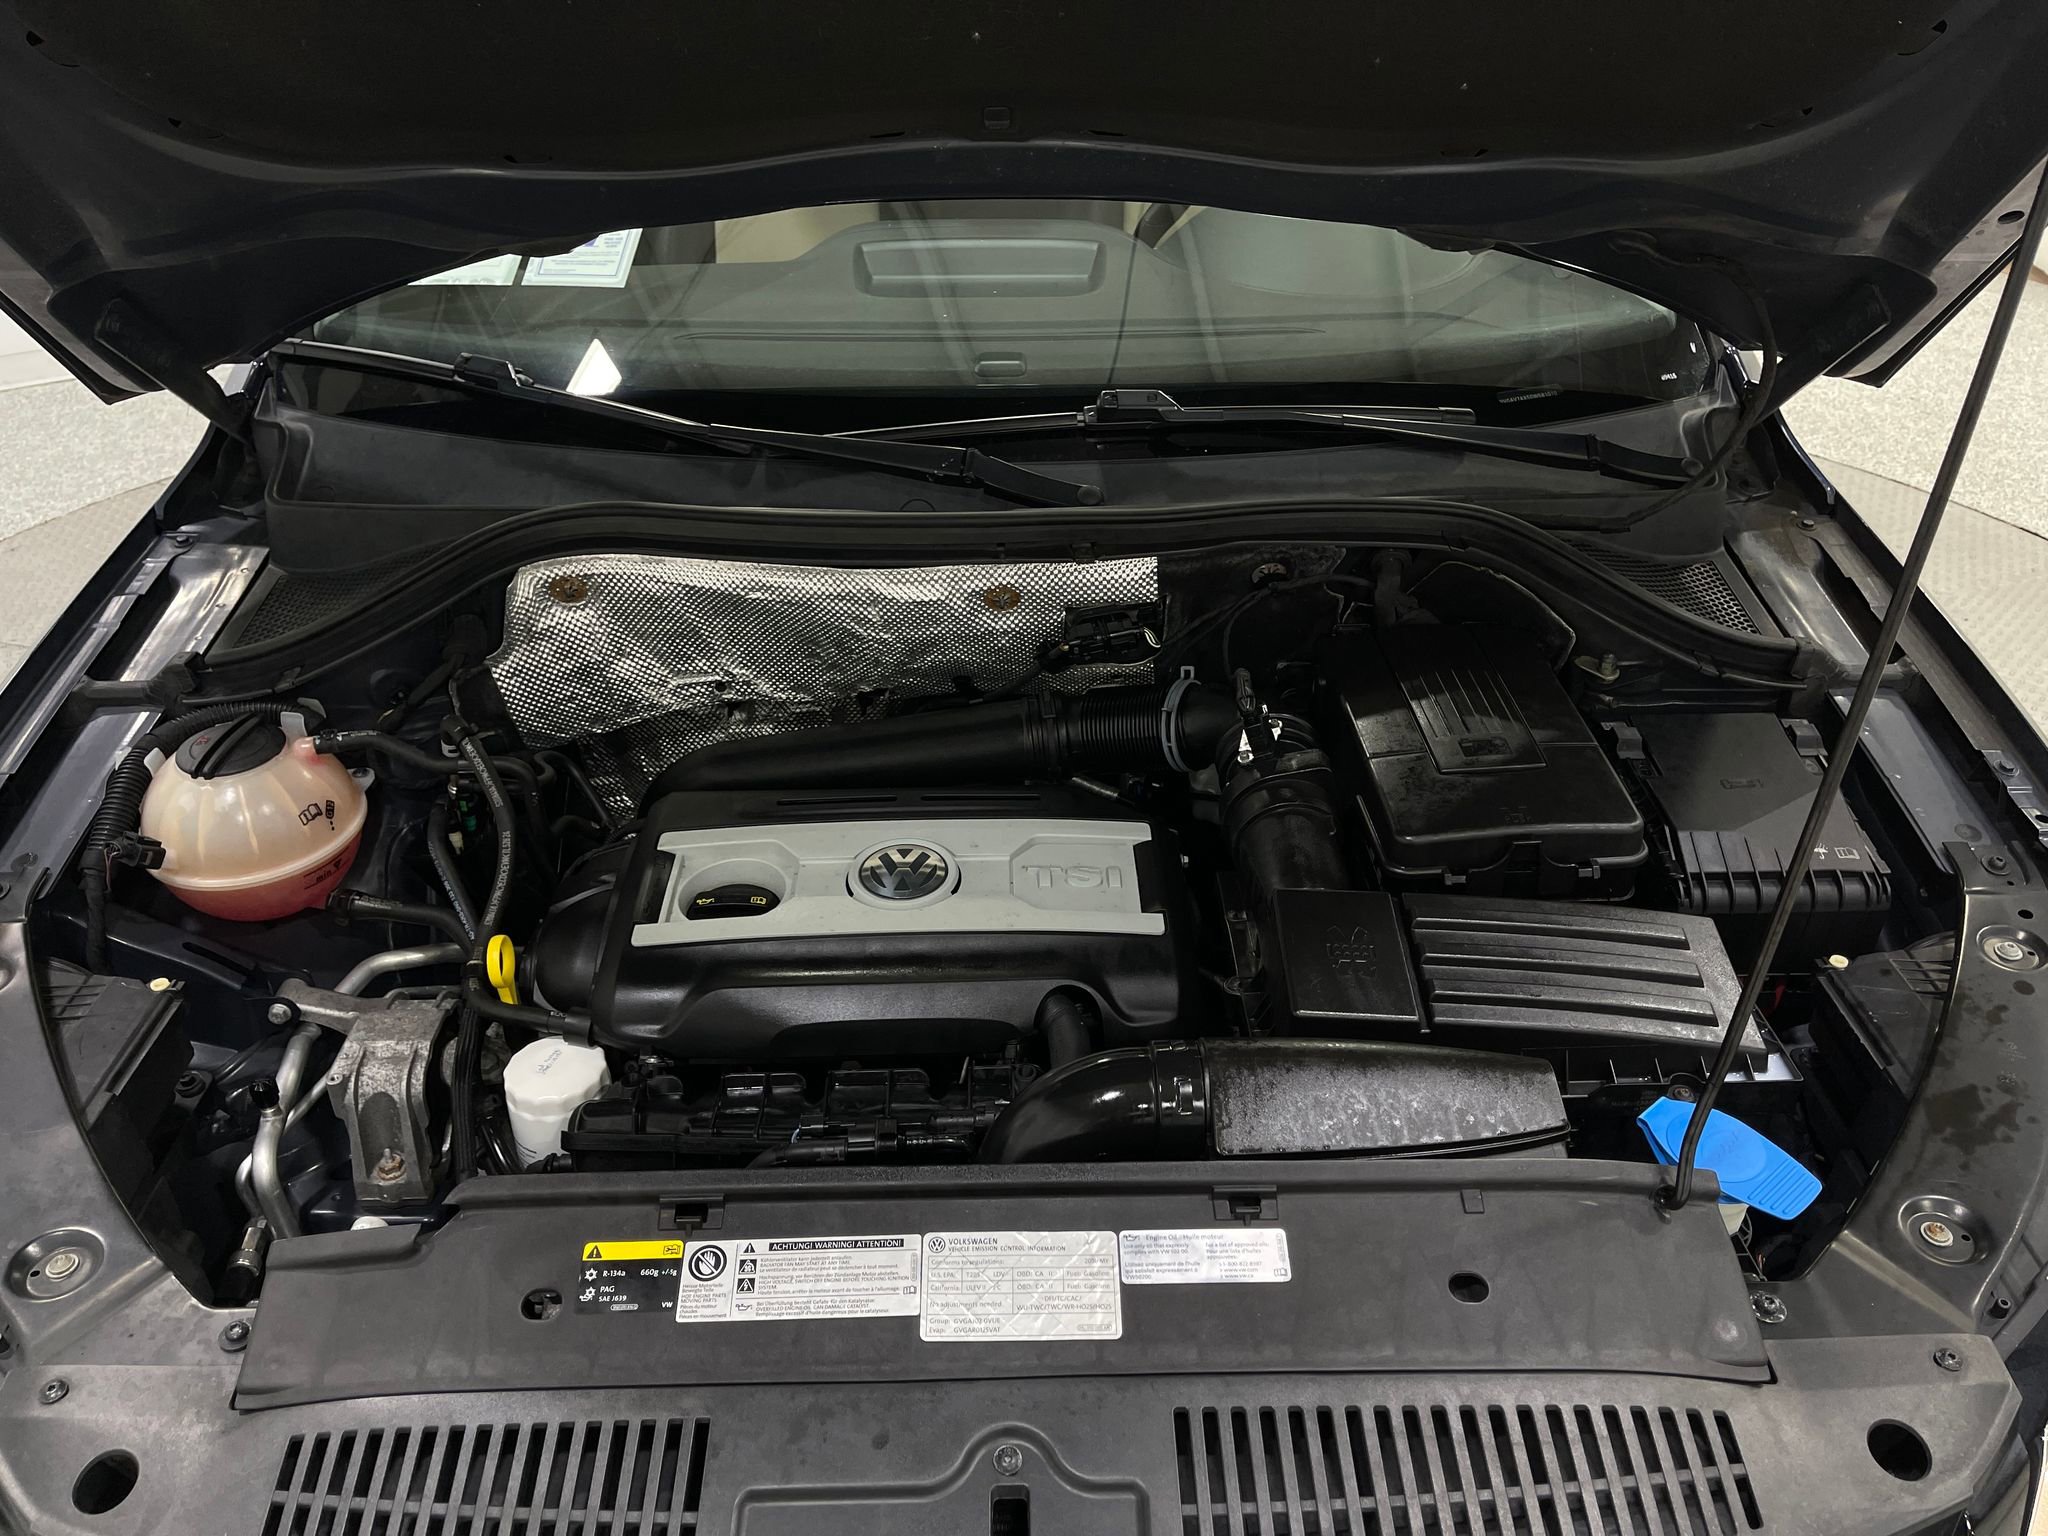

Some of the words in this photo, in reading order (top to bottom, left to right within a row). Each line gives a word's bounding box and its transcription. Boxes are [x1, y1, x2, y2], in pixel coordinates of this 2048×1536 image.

[316, 869, 333, 883] min
[1026, 864, 1122, 889] TSI
[772, 1243, 812, 1251] ACHTUNG!
[815, 1241, 855, 1250] WARNING!
[856, 1239, 901, 1248] ATTENTION!
[640, 1269, 659, 1277] 660g
